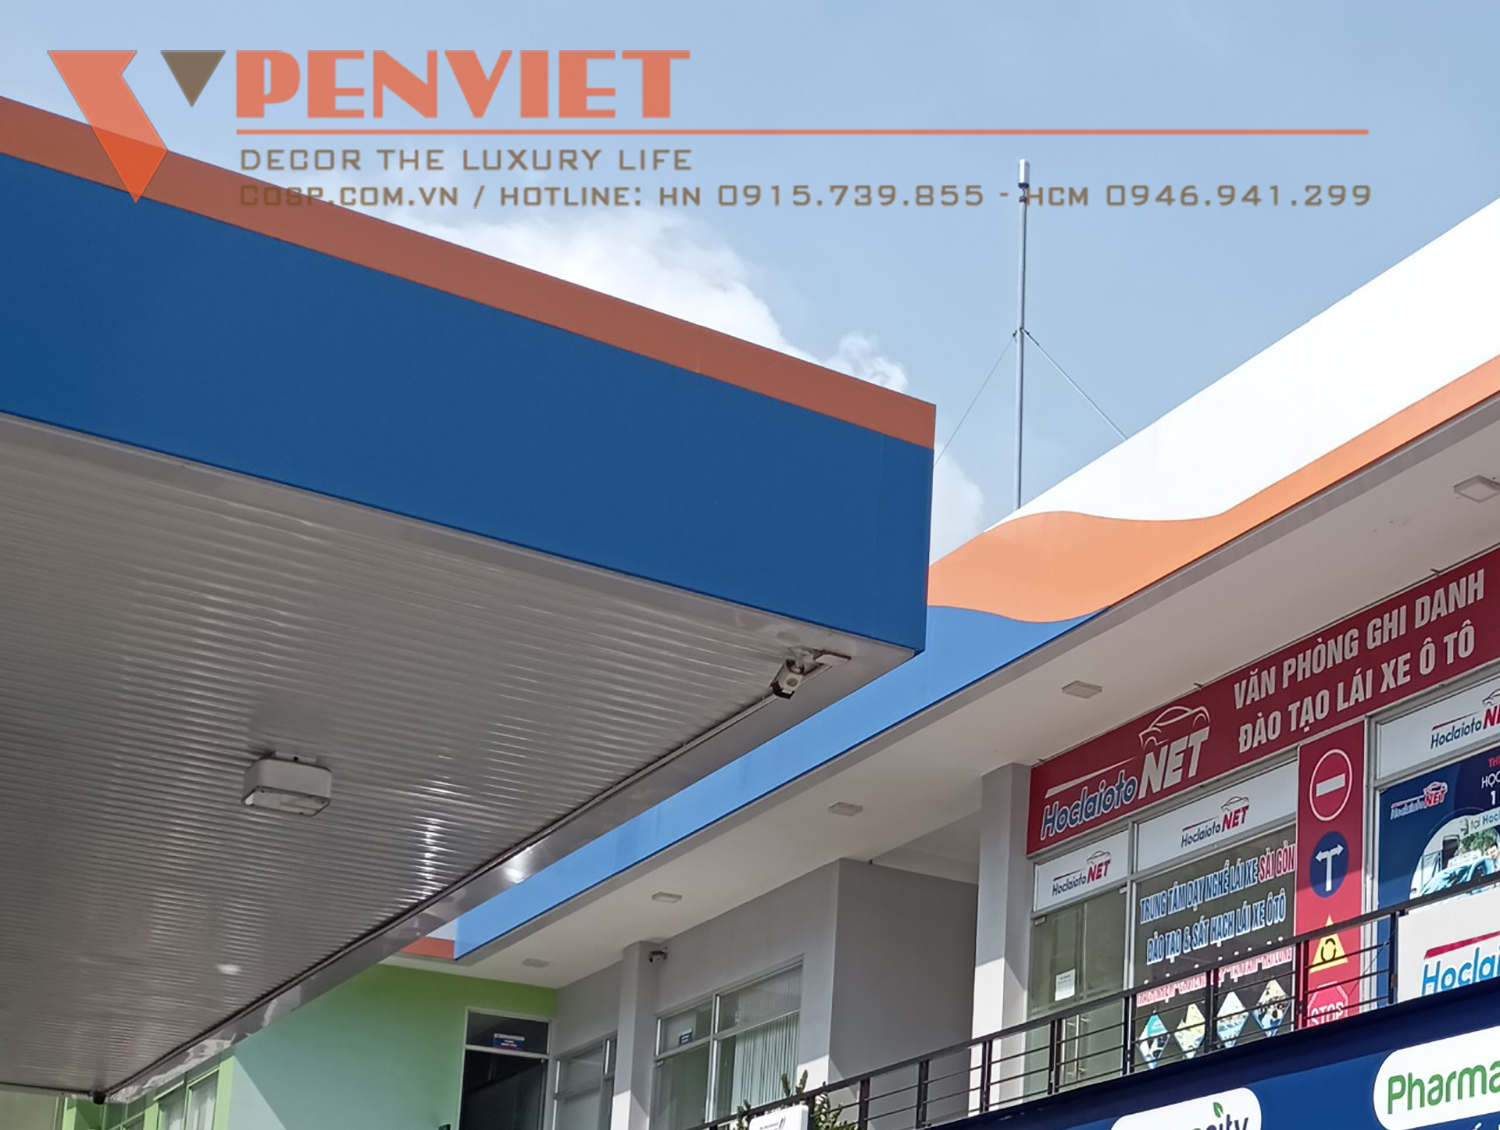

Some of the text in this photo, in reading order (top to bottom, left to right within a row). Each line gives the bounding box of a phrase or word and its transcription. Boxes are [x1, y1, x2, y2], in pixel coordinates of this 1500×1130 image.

[1233, 568, 1485, 710] VĂN PHÒNG GHI DANH
[1238, 620, 1476, 754] ĐÀO TẠO LÁI XE Ô TÔ
